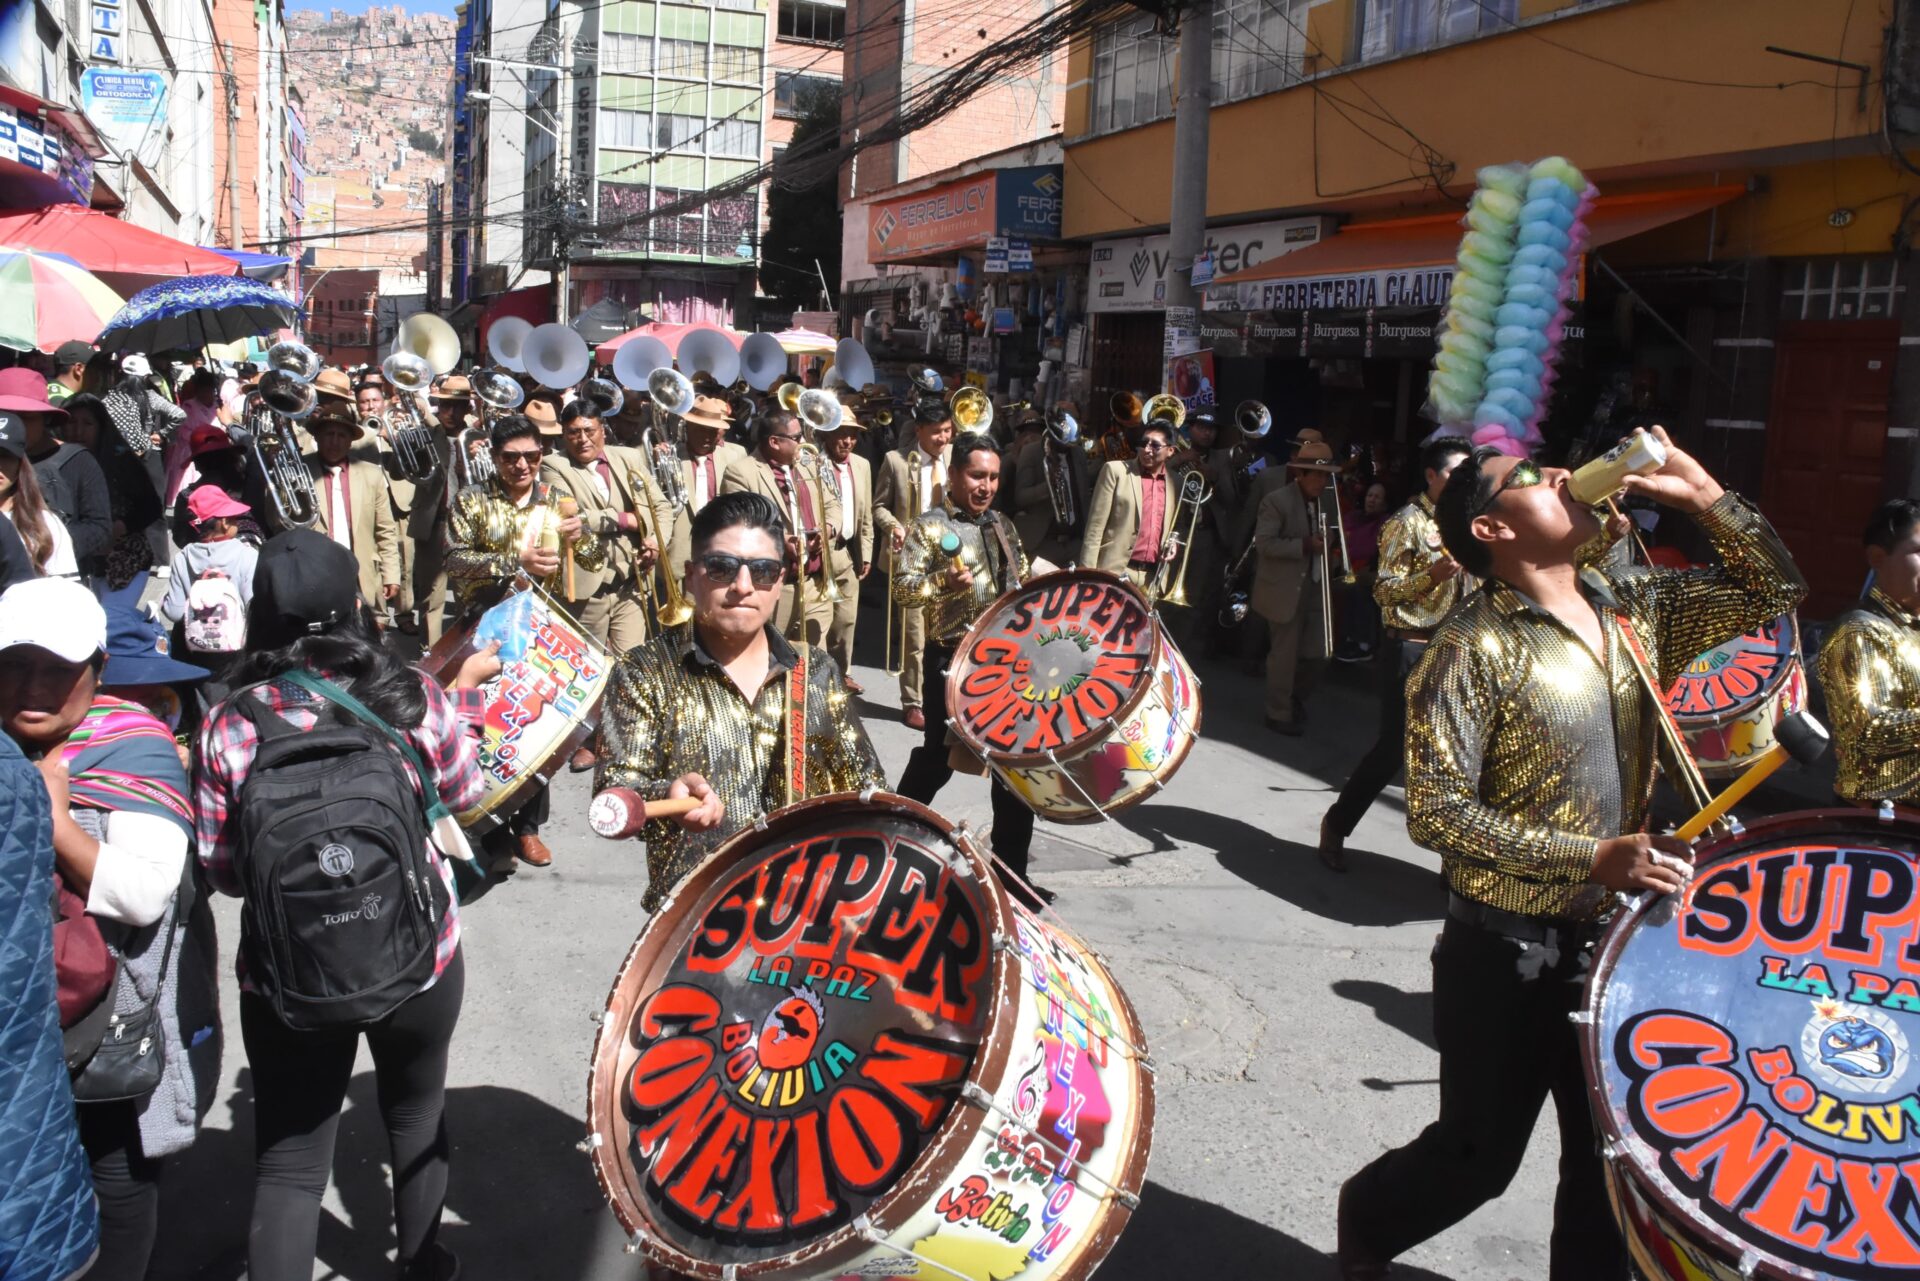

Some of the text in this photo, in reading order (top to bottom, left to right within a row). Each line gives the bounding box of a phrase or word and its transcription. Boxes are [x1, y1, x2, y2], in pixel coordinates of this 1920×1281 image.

[94, 1, 118, 58] TA
[96, 90, 153, 98] ORTODONCIA
[900, 183, 991, 228] FERRELUCY
[1263, 275, 1378, 310] FERRETERIA
[1254, 325, 1296, 340] Burguesa
[1313, 323, 1360, 340] Burguesa
[1379, 322, 1431, 341] Burguesa
[1003, 582, 1143, 653] SUPER
[1034, 623, 1099, 652] LA PAZ
[960, 637, 1148, 752] CONEXION
[1012, 658, 1089, 702] BOLIVIA
[687, 831, 993, 1024] SUPER
[1679, 846, 1920, 972] SUP
[747, 955, 880, 1002] LA PAZ
[1757, 956, 1838, 998] LA
[630, 983, 980, 1243] CONEXION
[1614, 1008, 1920, 1270] CONEX
[935, 1174, 1031, 1243] Bolivia
